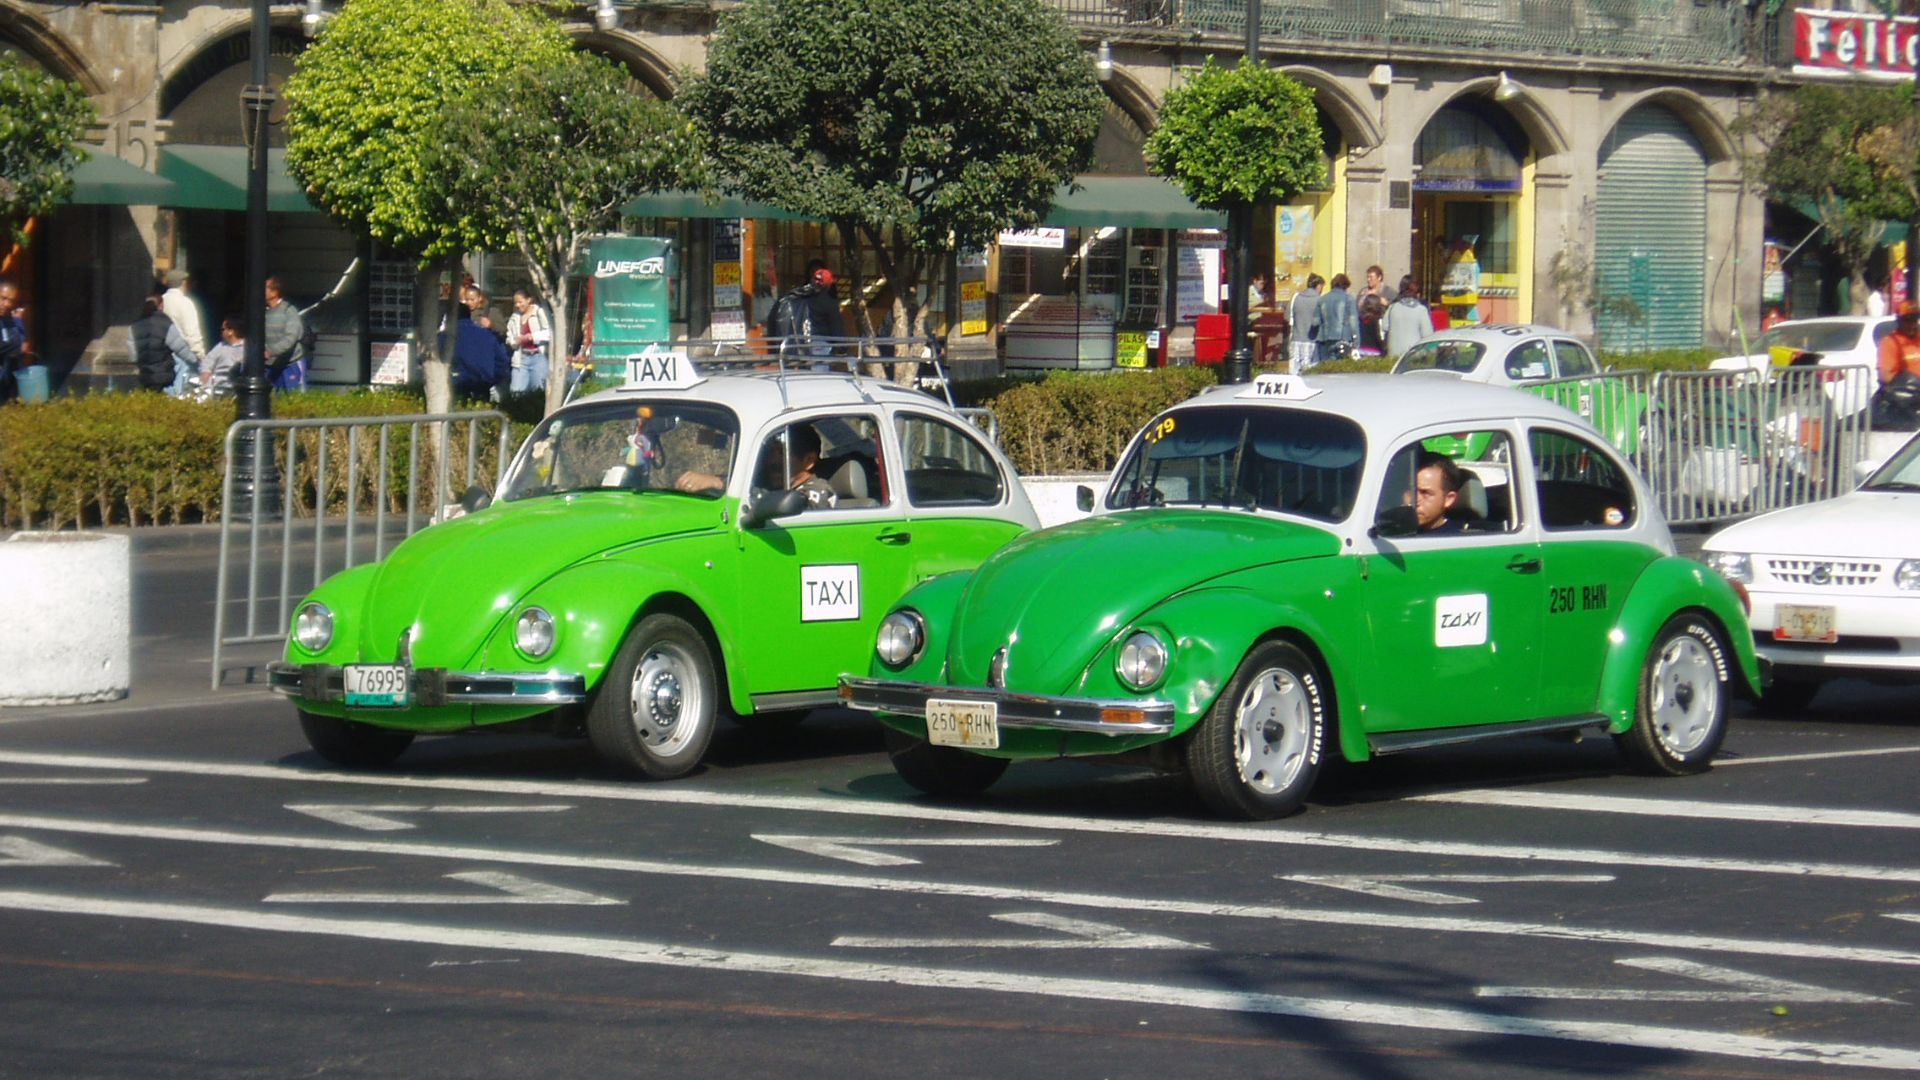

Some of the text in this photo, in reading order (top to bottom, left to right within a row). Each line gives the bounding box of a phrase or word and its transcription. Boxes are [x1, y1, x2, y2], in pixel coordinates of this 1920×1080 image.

[597, 259, 664, 274] UNEFON
[1118, 334, 1143, 344] PILAS
[629, 357, 677, 382] TAXI
[1256, 382, 1289, 395] TAXI
[806, 580, 853, 606] TAXI
[1550, 583, 1607, 613] 250 RHN
[1441, 611, 1481, 629] TAXI
